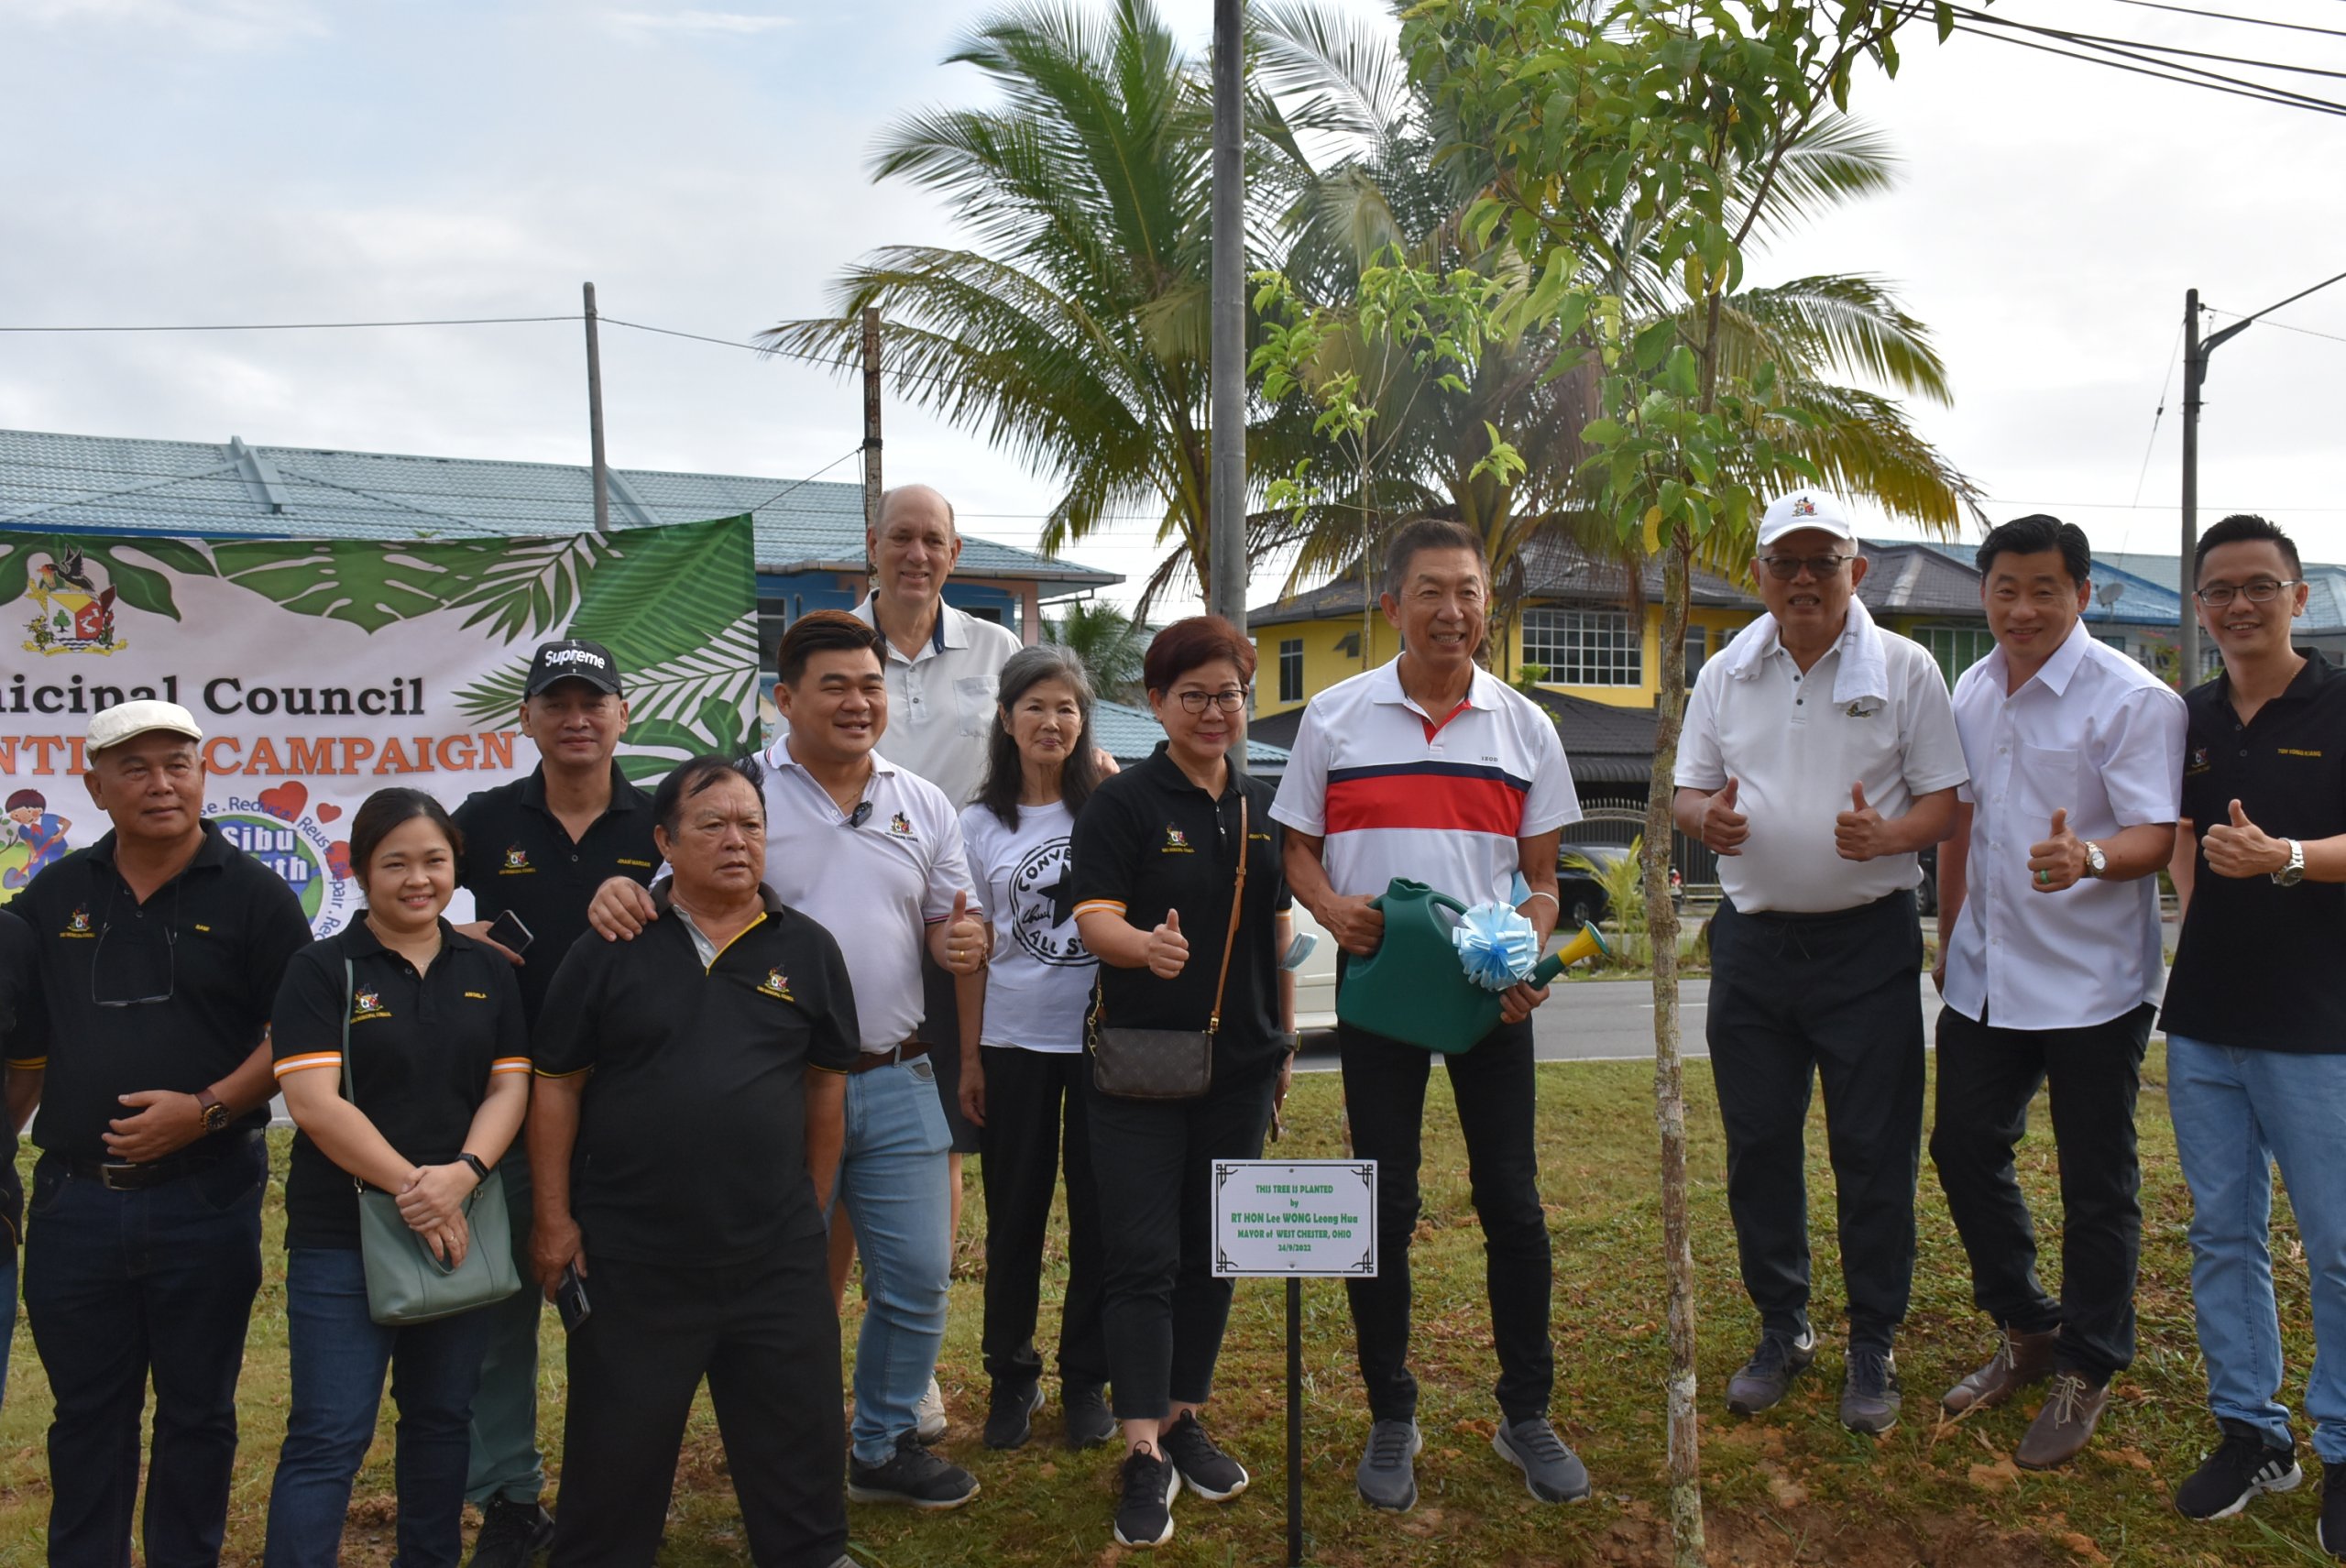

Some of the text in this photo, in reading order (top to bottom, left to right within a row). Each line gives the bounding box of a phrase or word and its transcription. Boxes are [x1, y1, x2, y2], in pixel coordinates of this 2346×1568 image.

[545, 649, 605, 669] Supreme
[203, 677, 425, 716] Council
[202, 732, 517, 776] CAMPAIGN
[229, 796, 292, 821] Reduce
[221, 827, 294, 851] Sibu
[297, 816, 334, 856] Reuse
[1029, 930, 1058, 954] ALL
[1255, 1185, 1333, 1194] THIS TREE IS PLANTED
[1289, 1198, 1299, 1208] by
[1231, 1212, 1358, 1225] RT HON Lee WONG Leong Hua
[1237, 1229, 1352, 1239] MAYOR of WEST CHESTER, OHIO
